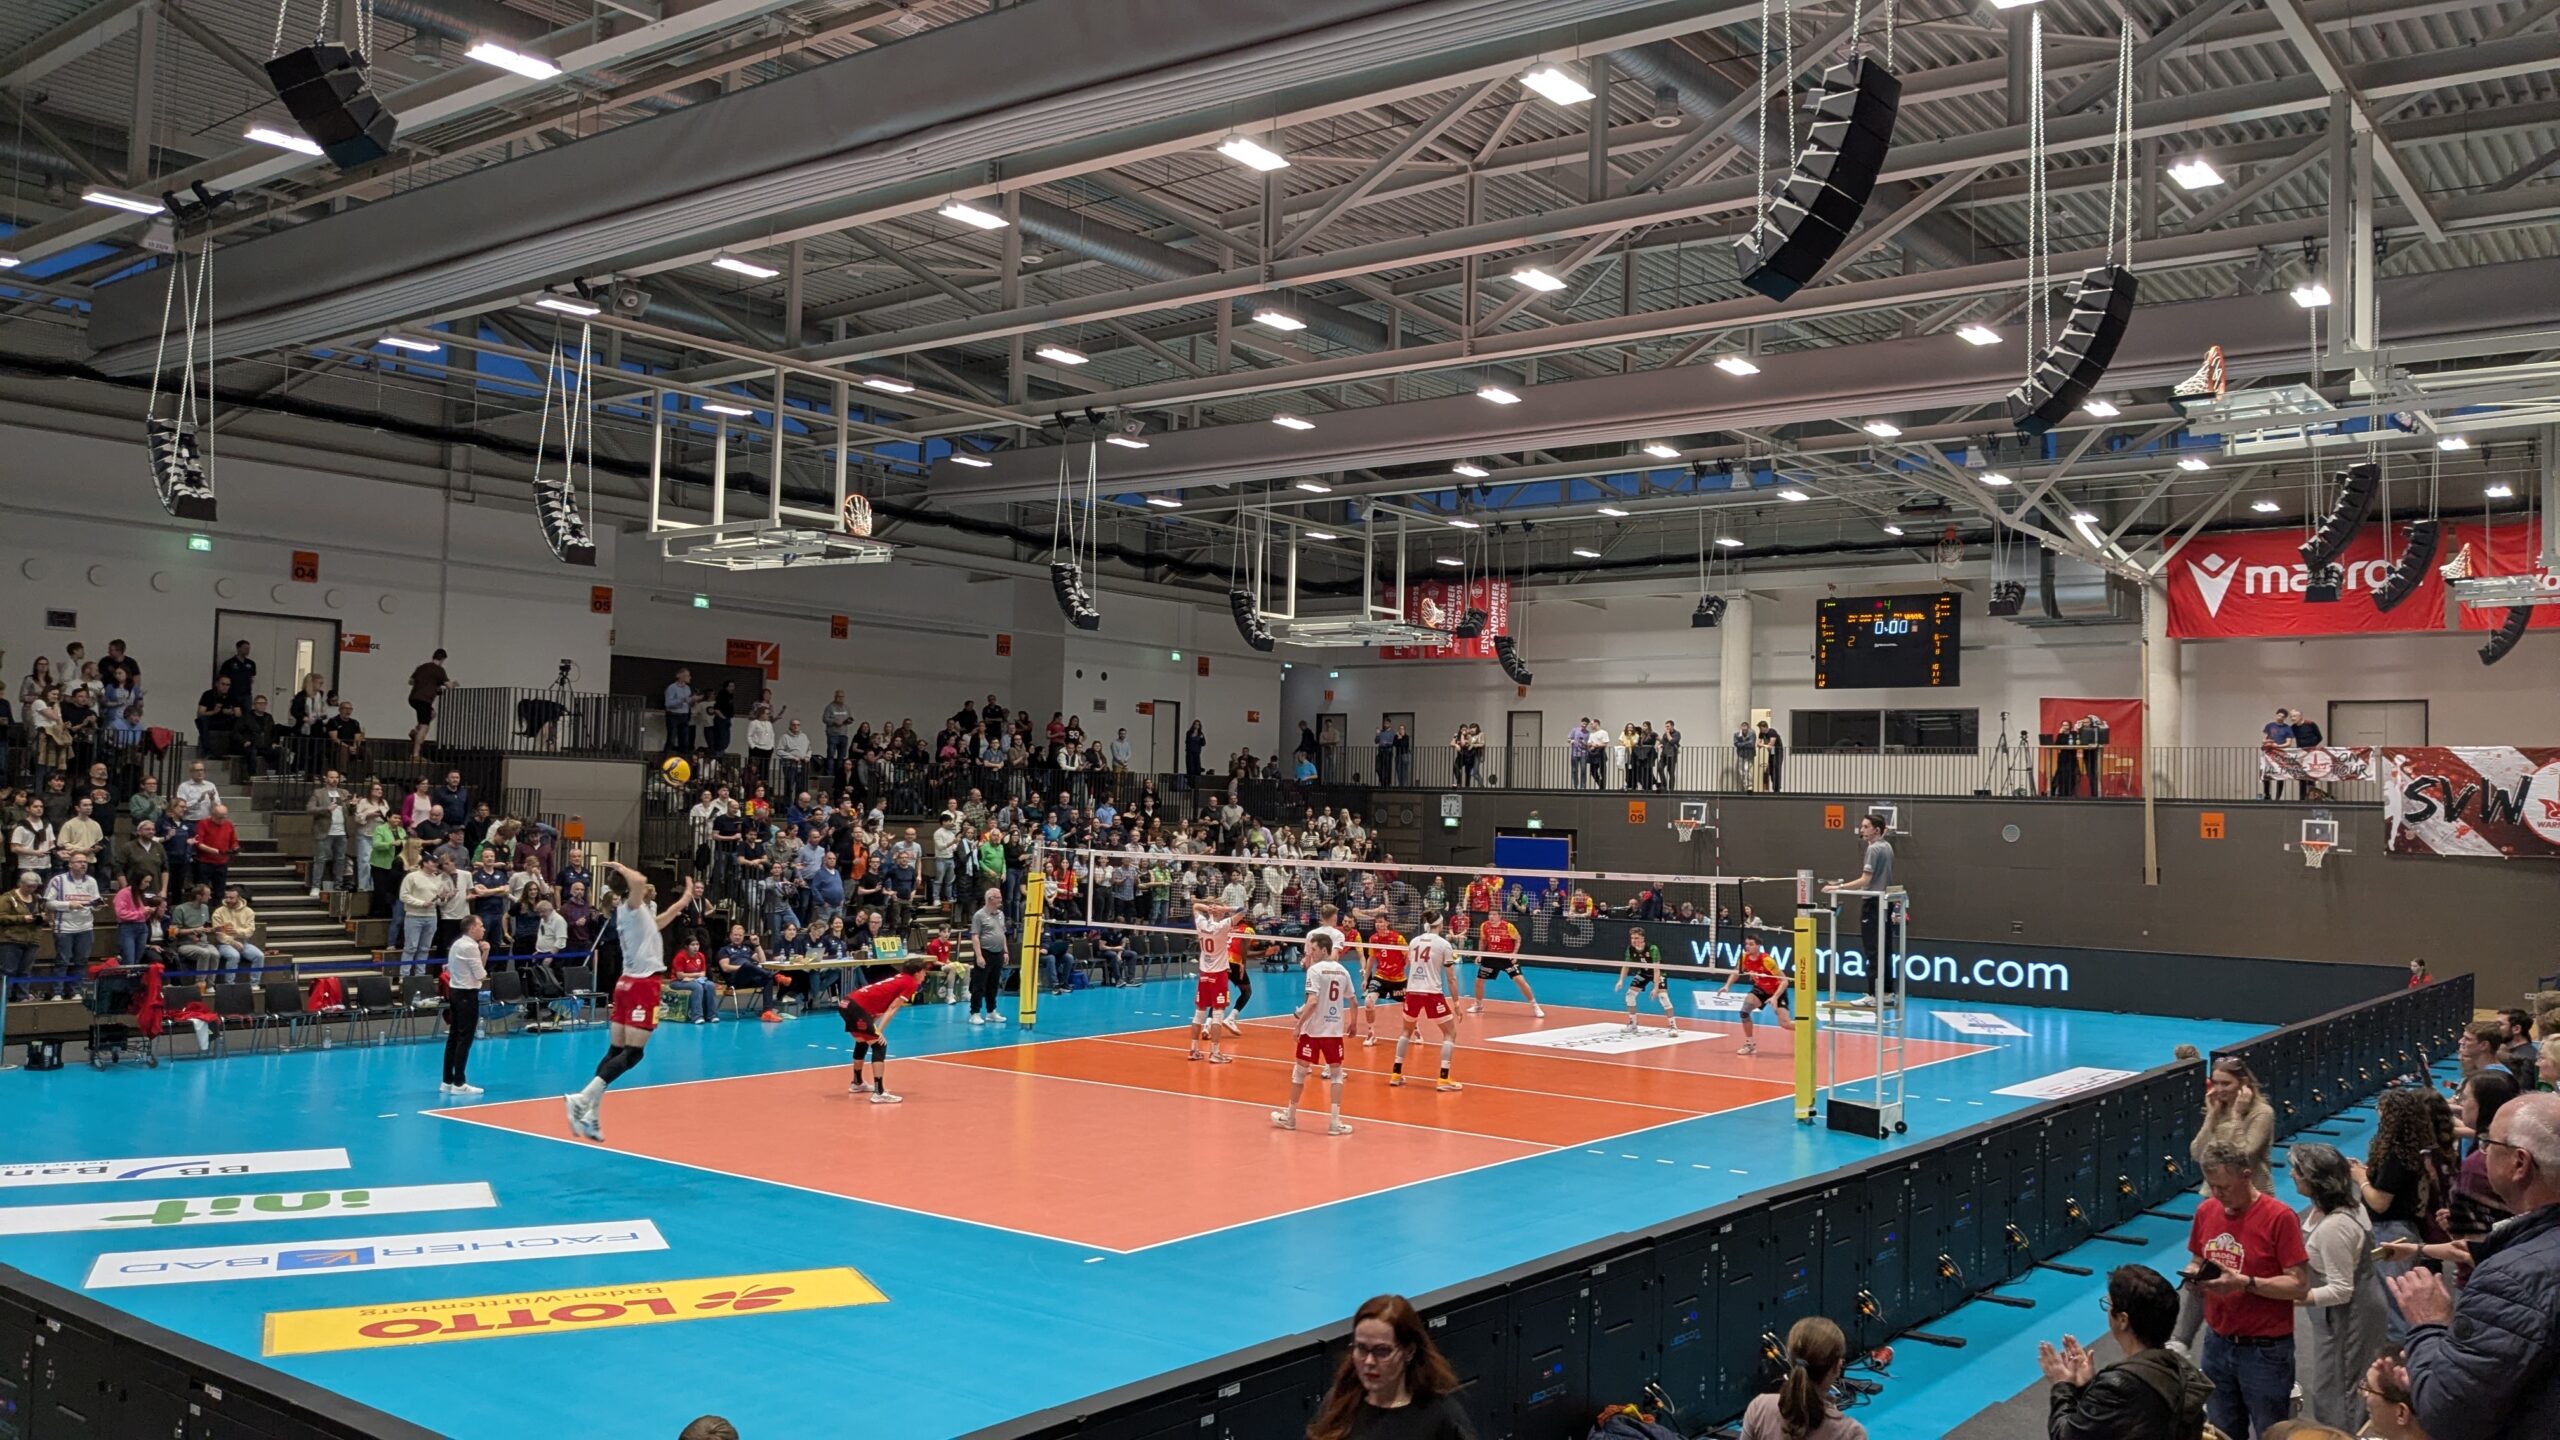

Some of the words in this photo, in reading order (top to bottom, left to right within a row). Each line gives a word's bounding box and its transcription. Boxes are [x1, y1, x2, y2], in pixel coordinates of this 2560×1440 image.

[294, 566, 316, 579] 04
[2245, 558, 2423, 595] maro
[1481, 628, 1489, 654] JENS
[2403, 774, 2533, 826] SVW
[1629, 813, 1645, 823] 09
[1827, 818, 1841, 828] 10
[2205, 827, 2218, 838] 11
[1200, 937, 1214, 954] 10
[1413, 945, 1431, 963] 14
[1691, 939, 2069, 992] www.maron.com
[1329, 980, 1339, 1002] 6
[178, 1165, 249, 1176] BB
[98, 1189, 371, 1225] init
[383, 1231, 639, 1257] FÄCHER
[120, 1257, 270, 1274] BAD
[359, 1287, 663, 1318] Baden-Württemberg
[358, 1297, 677, 1340] LOTTO
